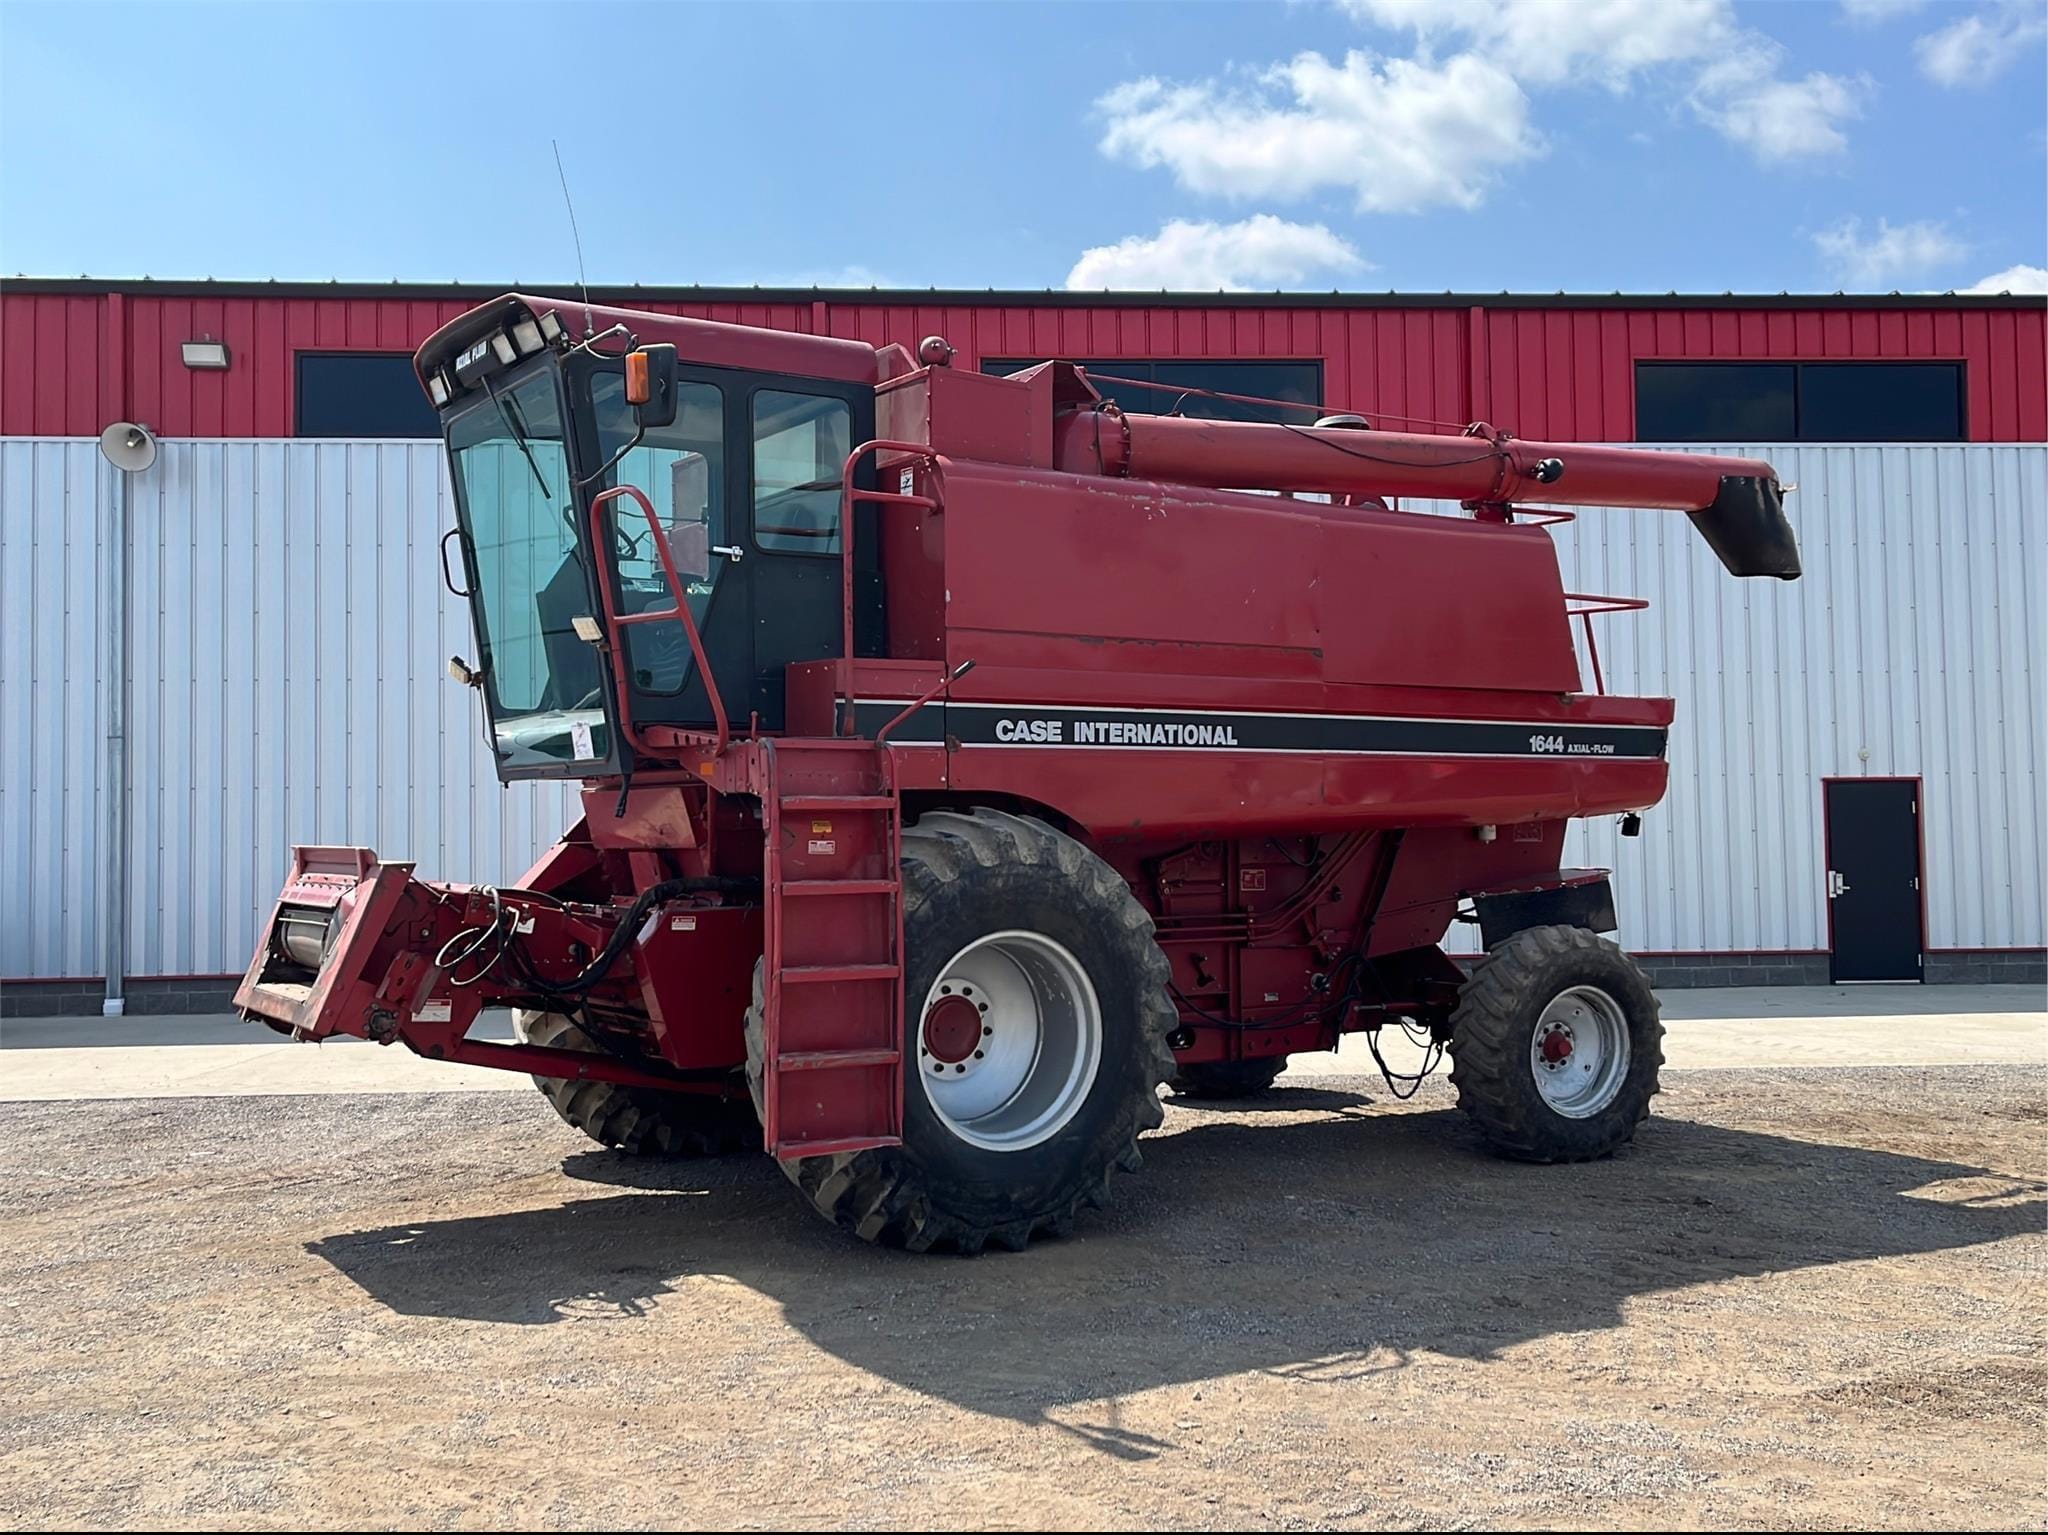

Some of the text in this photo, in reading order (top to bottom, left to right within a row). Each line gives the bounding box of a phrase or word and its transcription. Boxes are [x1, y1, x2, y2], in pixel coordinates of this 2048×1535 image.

[995, 719, 1238, 746] CASE INTERNATIONAL
[1529, 735, 1615, 754] 1644 AXIAL-FLOW
